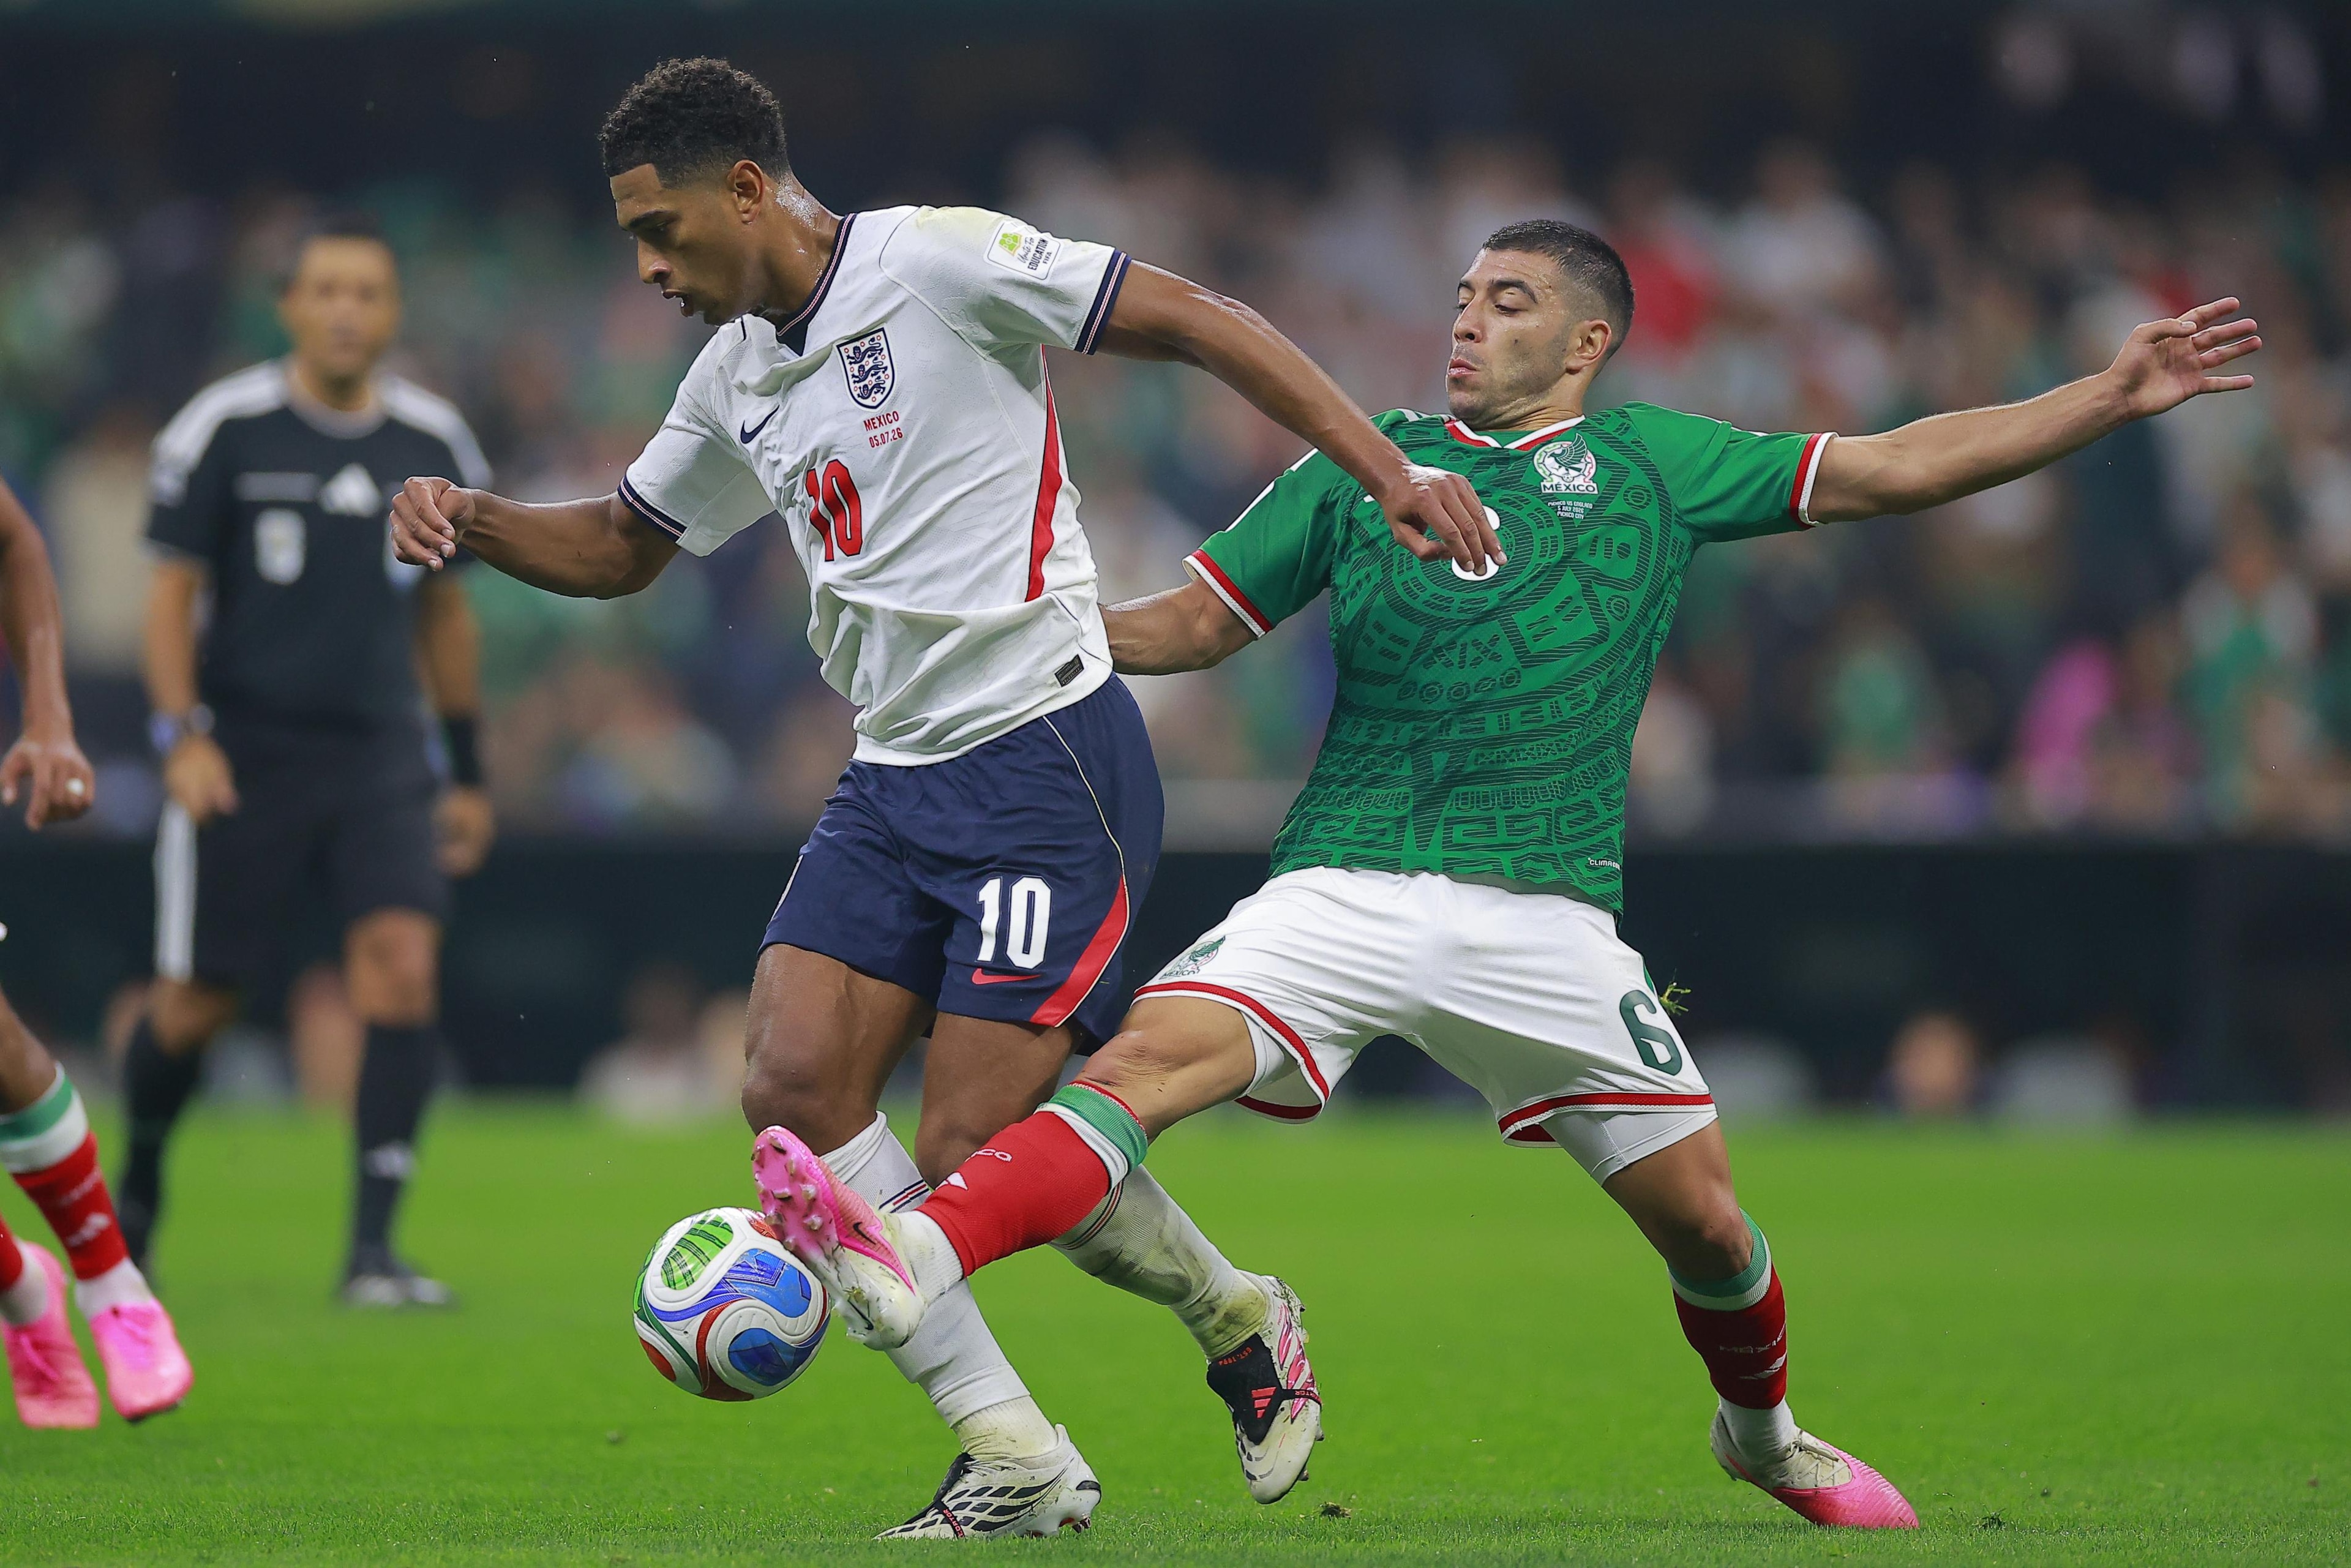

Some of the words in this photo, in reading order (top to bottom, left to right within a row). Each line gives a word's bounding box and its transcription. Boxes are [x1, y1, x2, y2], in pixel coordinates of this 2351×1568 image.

[1017, 246, 1031, 263] Unite
[1027, 238, 1048, 271] EDUCATION
[1043, 252, 1052, 264] FIFA
[863, 411, 899, 432] MEXICO
[869, 427, 903, 448] 05.07.26
[1543, 482, 1595, 492] MÉXICO
[805, 459, 863, 561] 10
[975, 875, 1053, 969] 10
[1619, 989, 1682, 1076] 6
